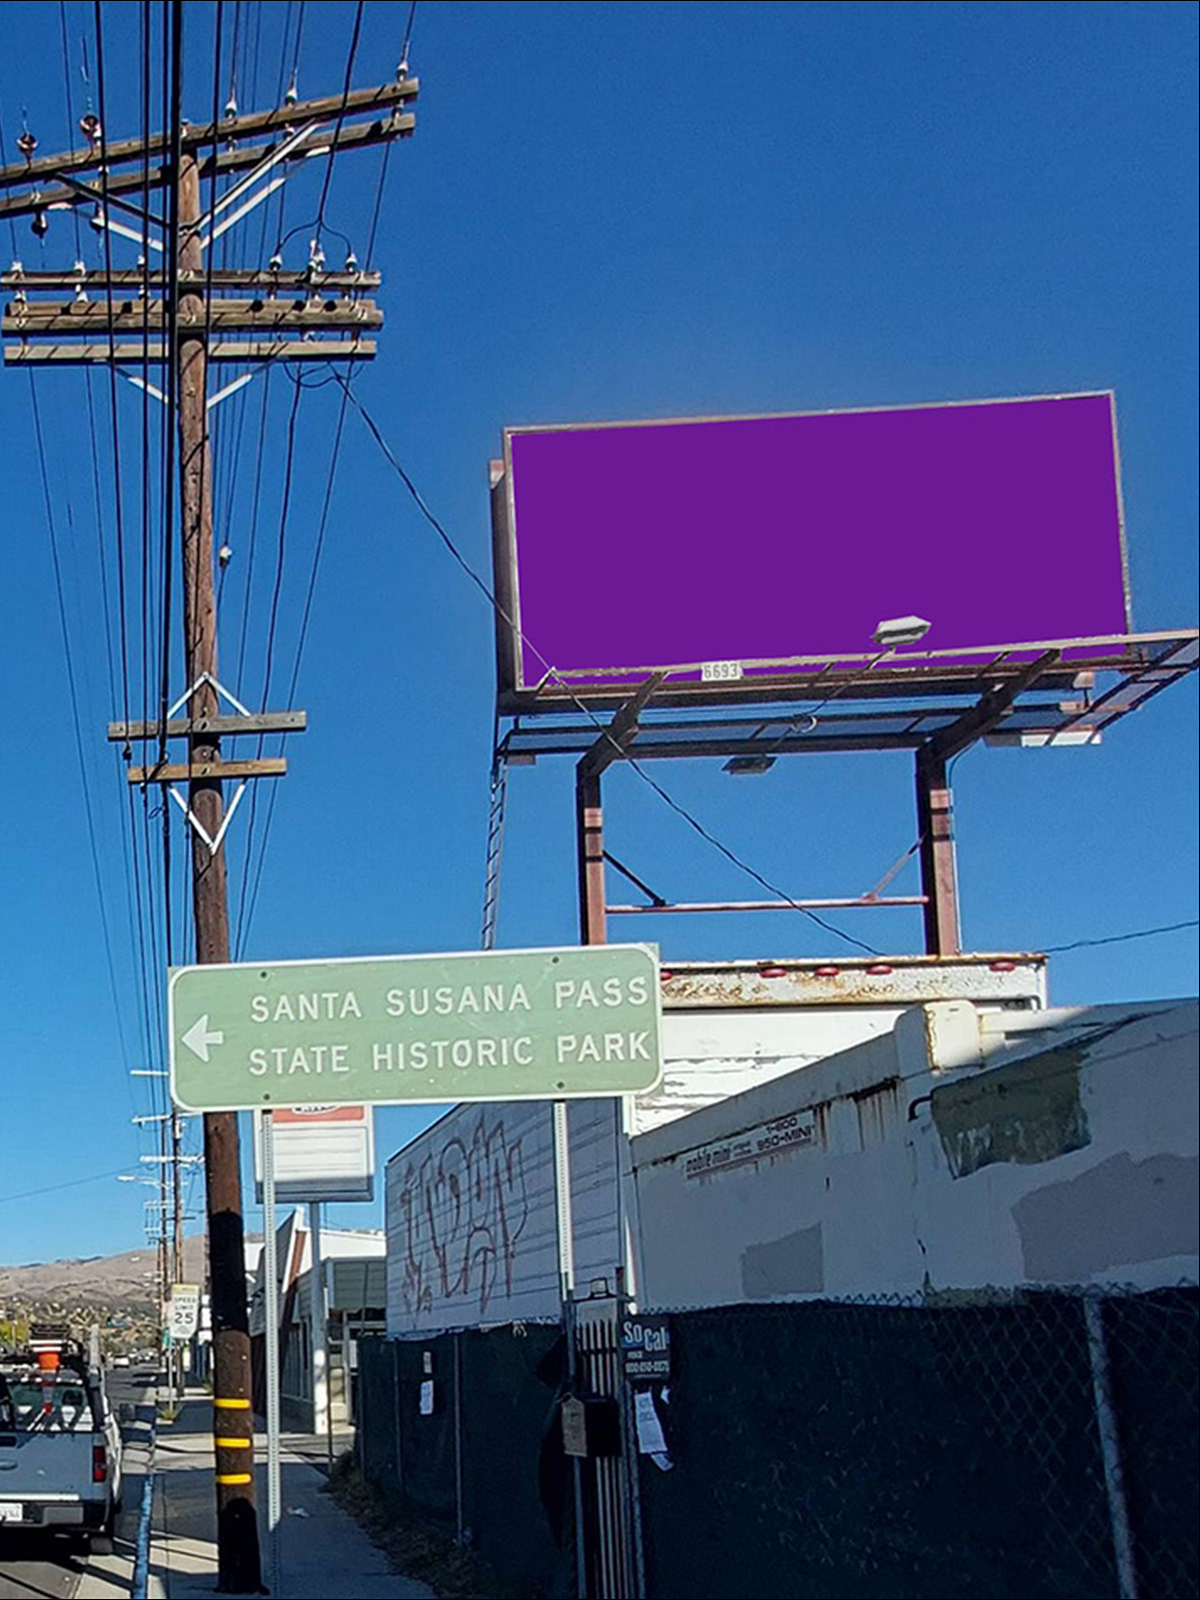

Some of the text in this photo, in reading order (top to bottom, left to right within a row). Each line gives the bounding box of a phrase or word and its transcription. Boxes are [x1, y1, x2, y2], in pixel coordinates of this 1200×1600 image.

[703, 663, 738, 679] 6693
[250, 975, 650, 1023] SANTA SUSANA PASS
[249, 1031, 651, 1076] STATE HISTORIC PARK
[174, 1296, 197, 1304] SPEED
[174, 1311, 194, 1325] 25
